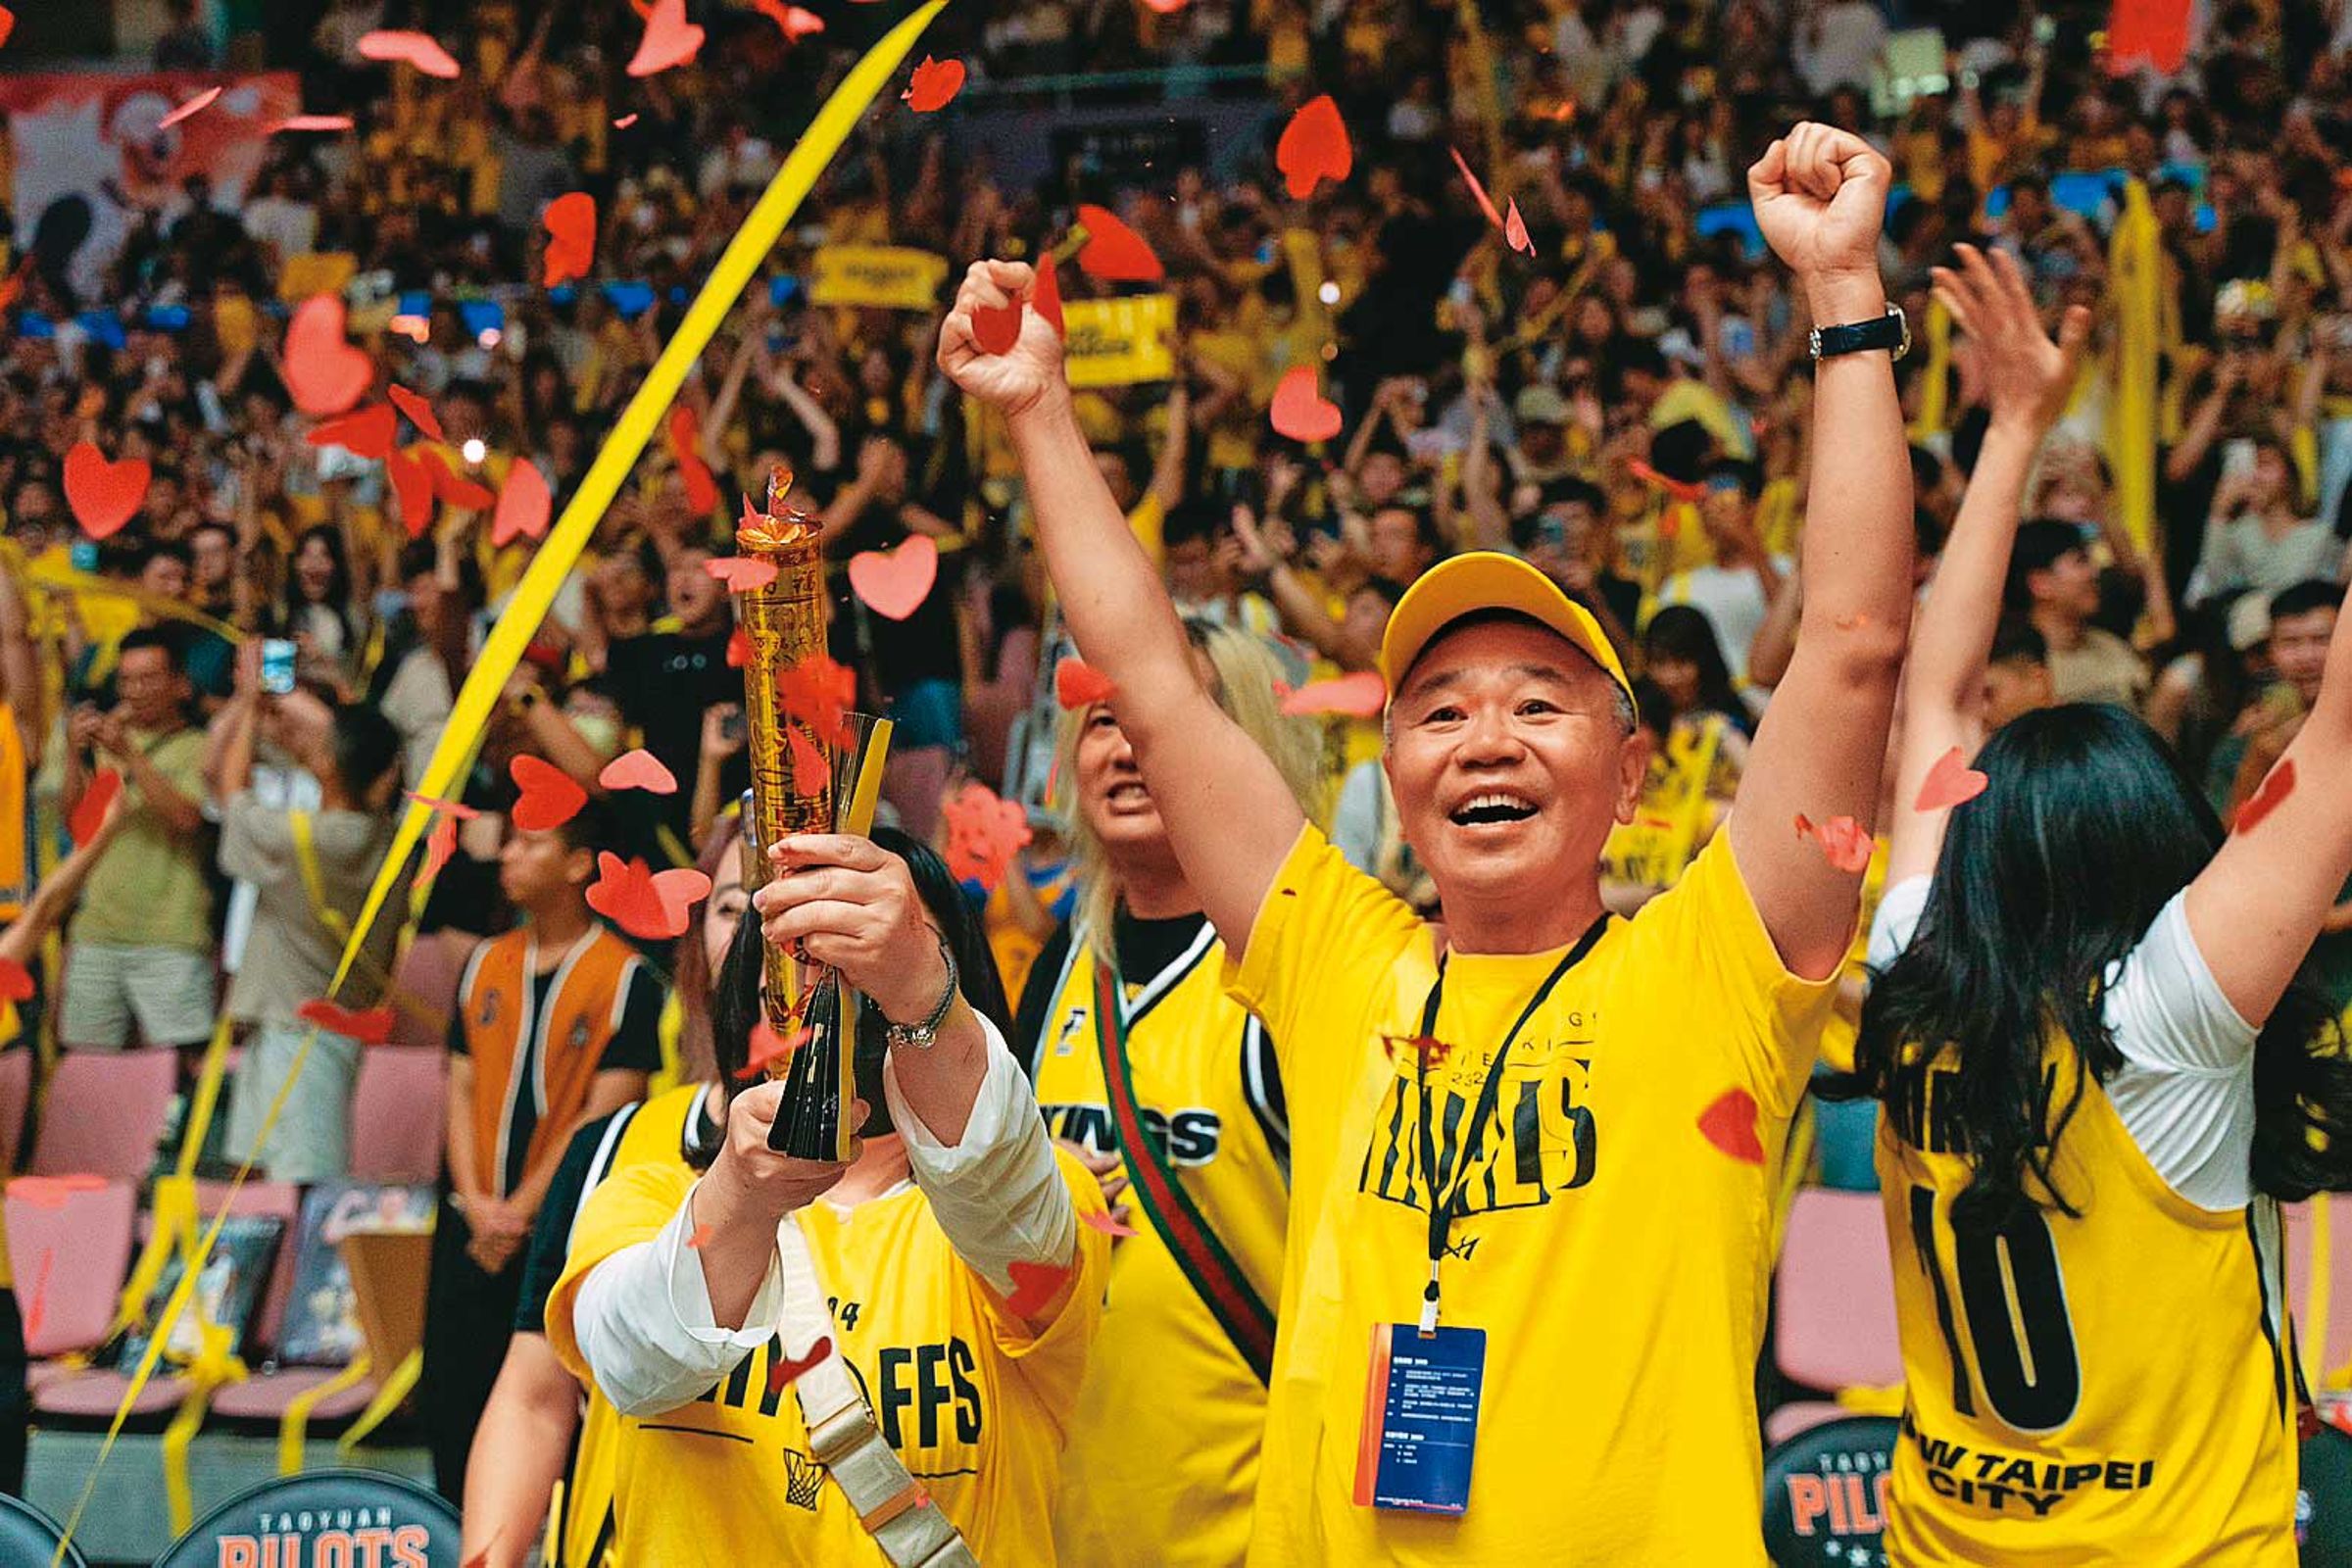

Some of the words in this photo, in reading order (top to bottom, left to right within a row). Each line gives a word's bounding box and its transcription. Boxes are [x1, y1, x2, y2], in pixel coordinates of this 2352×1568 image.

[1976, 1453, 2155, 1491] TAIPEI
[1927, 1468, 2065, 1515] CITY
[260, 1506, 392, 1533] TAOYUAN
